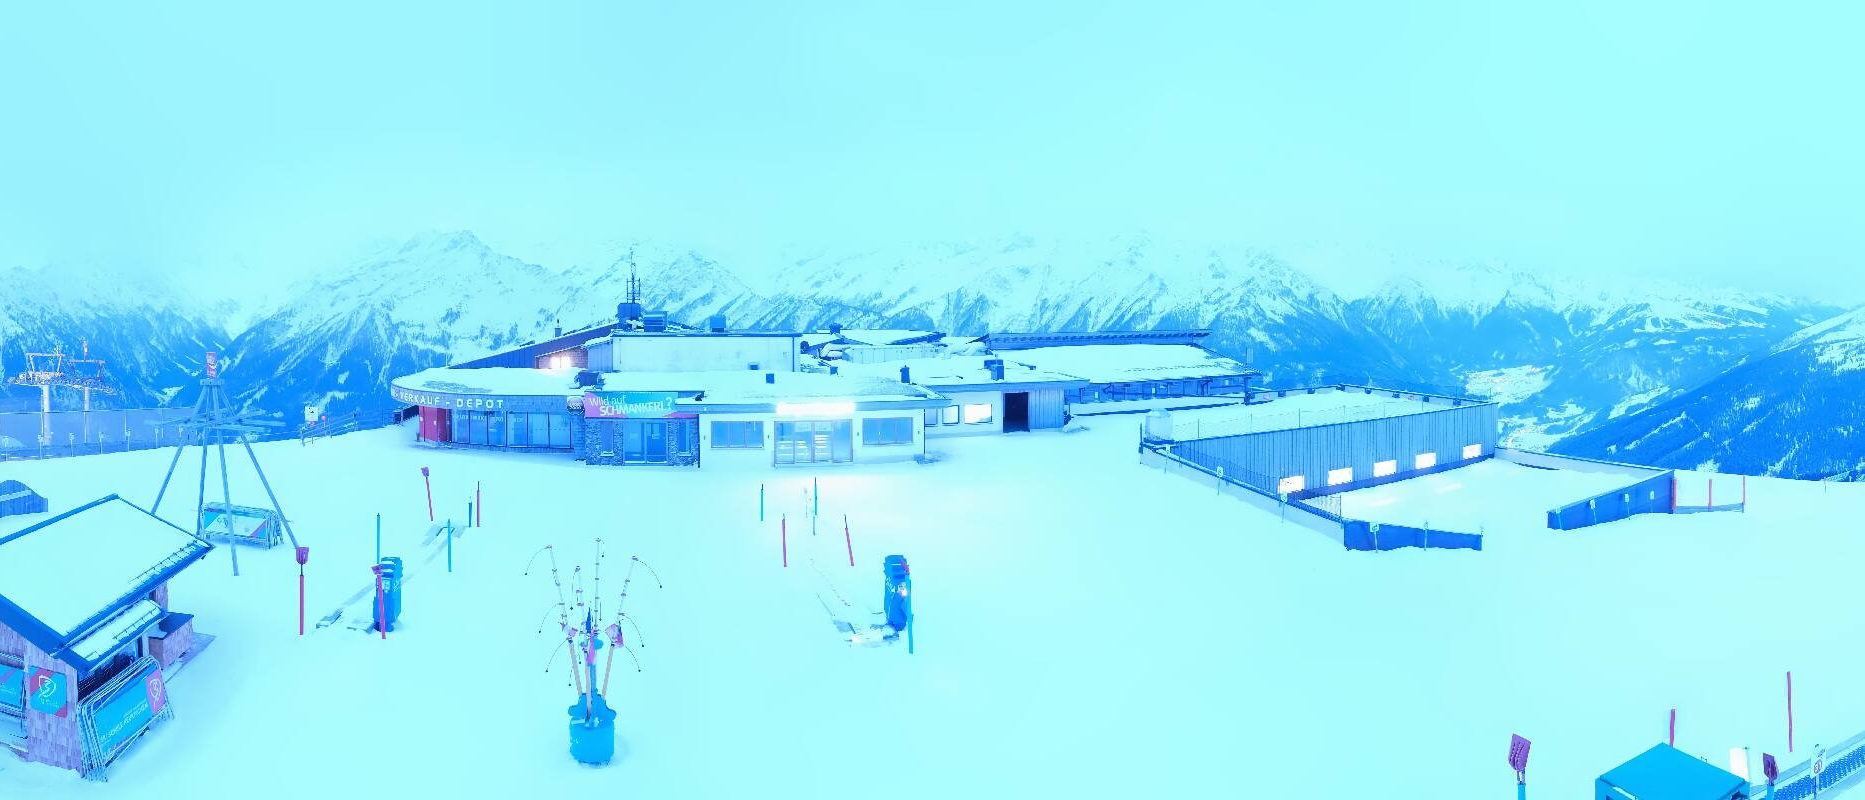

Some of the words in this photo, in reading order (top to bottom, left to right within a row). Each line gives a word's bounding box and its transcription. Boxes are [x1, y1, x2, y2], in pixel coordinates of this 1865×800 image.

[400, 392, 440, 405] VERKAUF
[456, 398, 504, 409] DEPOT
[590, 395, 609, 407] Wild
[611, 394, 627, 405] auf
